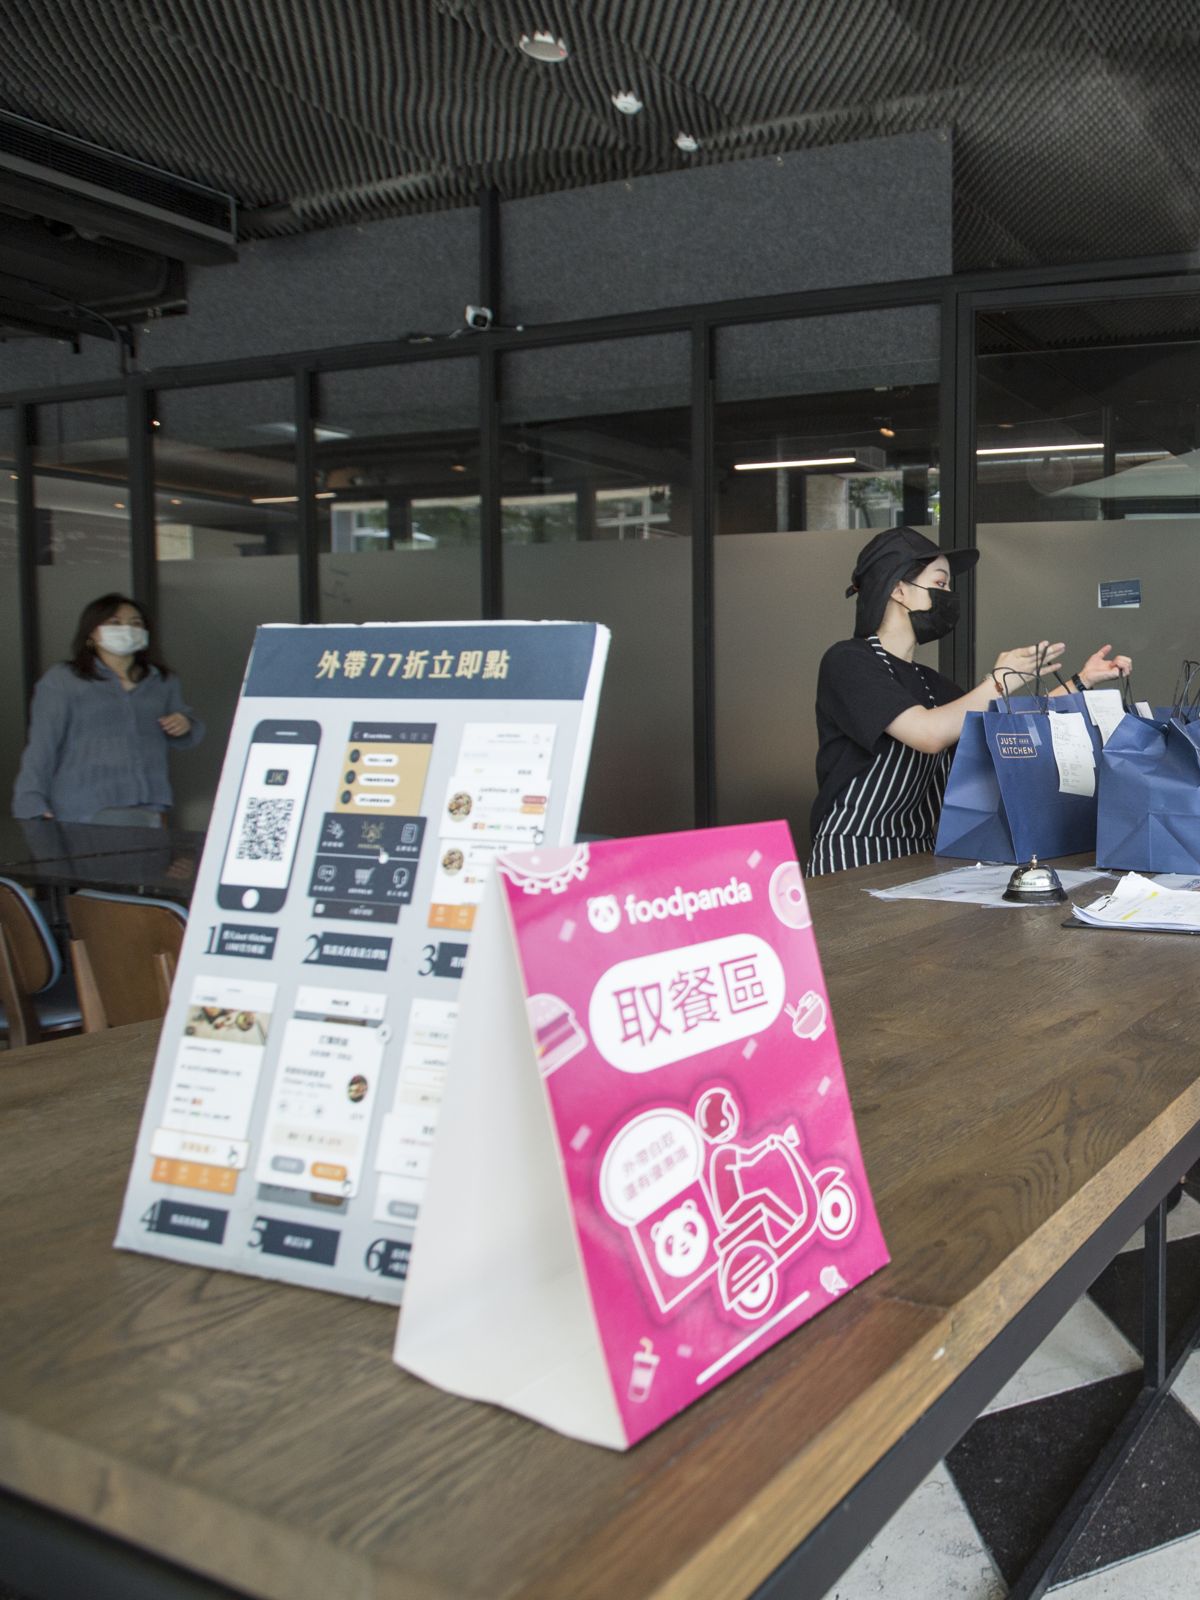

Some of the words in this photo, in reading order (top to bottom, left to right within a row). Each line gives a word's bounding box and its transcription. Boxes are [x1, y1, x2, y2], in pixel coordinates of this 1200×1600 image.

[315, 649, 510, 680] 外帶77折立即點
[1000, 737, 1017, 745] JUST
[1002, 746, 1034, 755] KITCHEN
[624, 876, 753, 925] foodpanda
[203, 926, 217, 954] 1
[301, 933, 322, 964] 2
[417, 944, 436, 976] 3
[612, 953, 769, 1047] 取餐區
[140, 1199, 159, 1232] 4
[246, 1216, 267, 1247] 5
[364, 1237, 384, 1272] 6
